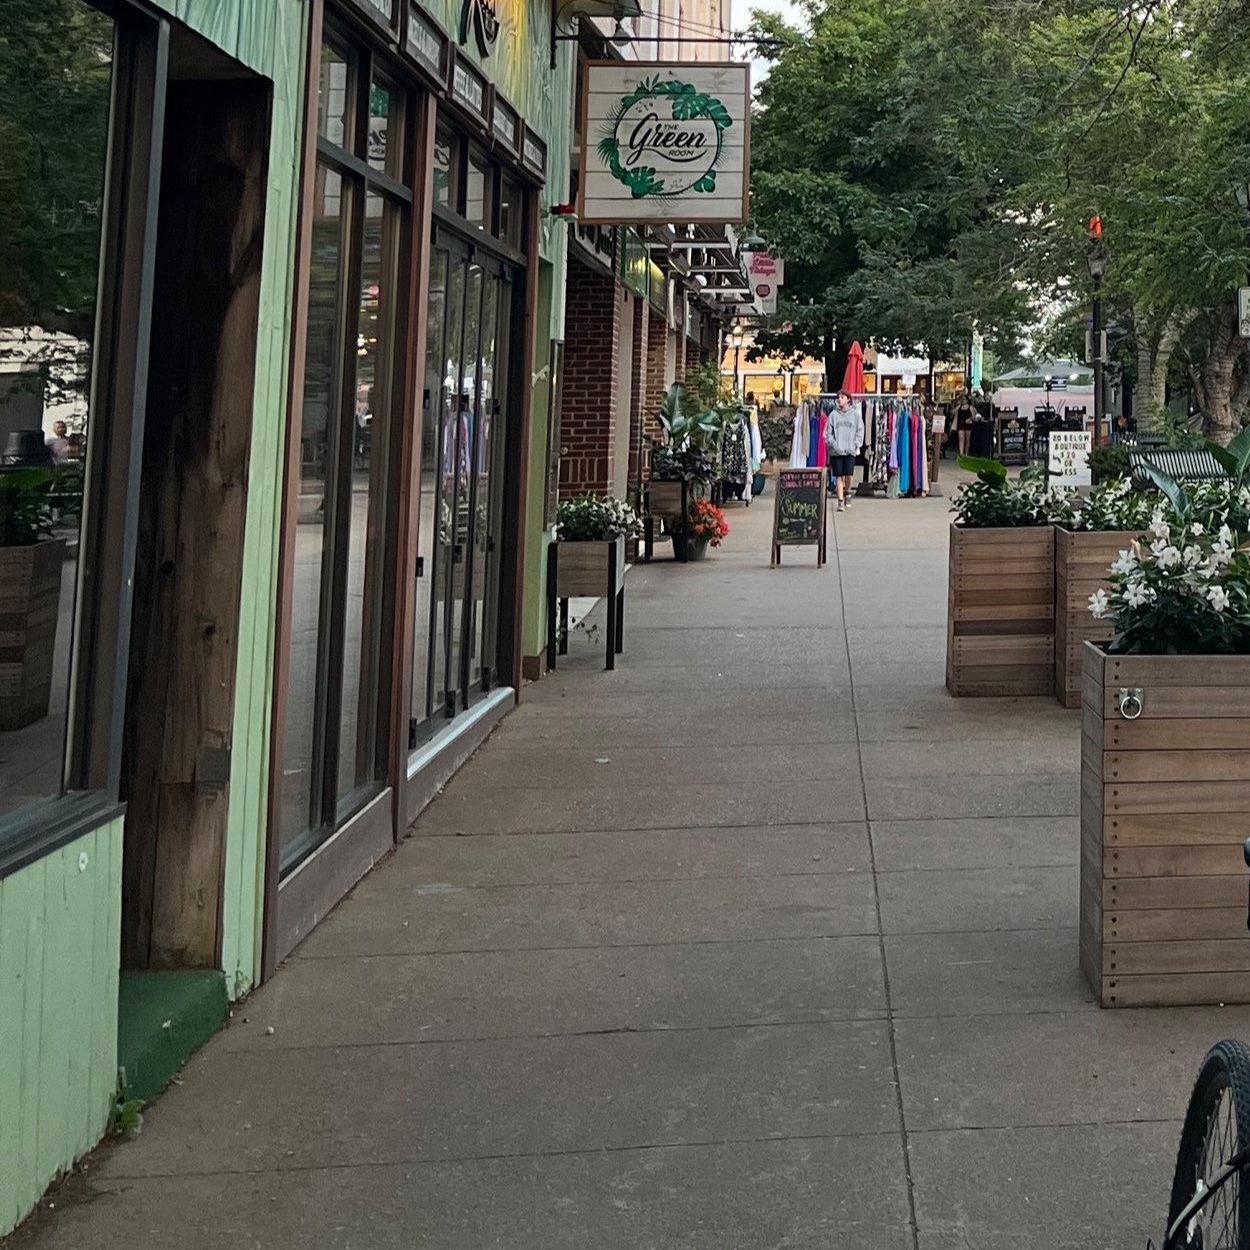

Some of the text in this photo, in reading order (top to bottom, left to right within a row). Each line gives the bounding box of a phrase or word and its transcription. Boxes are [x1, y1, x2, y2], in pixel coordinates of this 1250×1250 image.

[626, 112, 708, 166] Green
[1064, 434, 1089, 442] BELOW
[1064, 460, 1073, 468] OR
[782, 498, 818, 519] SUMMER
